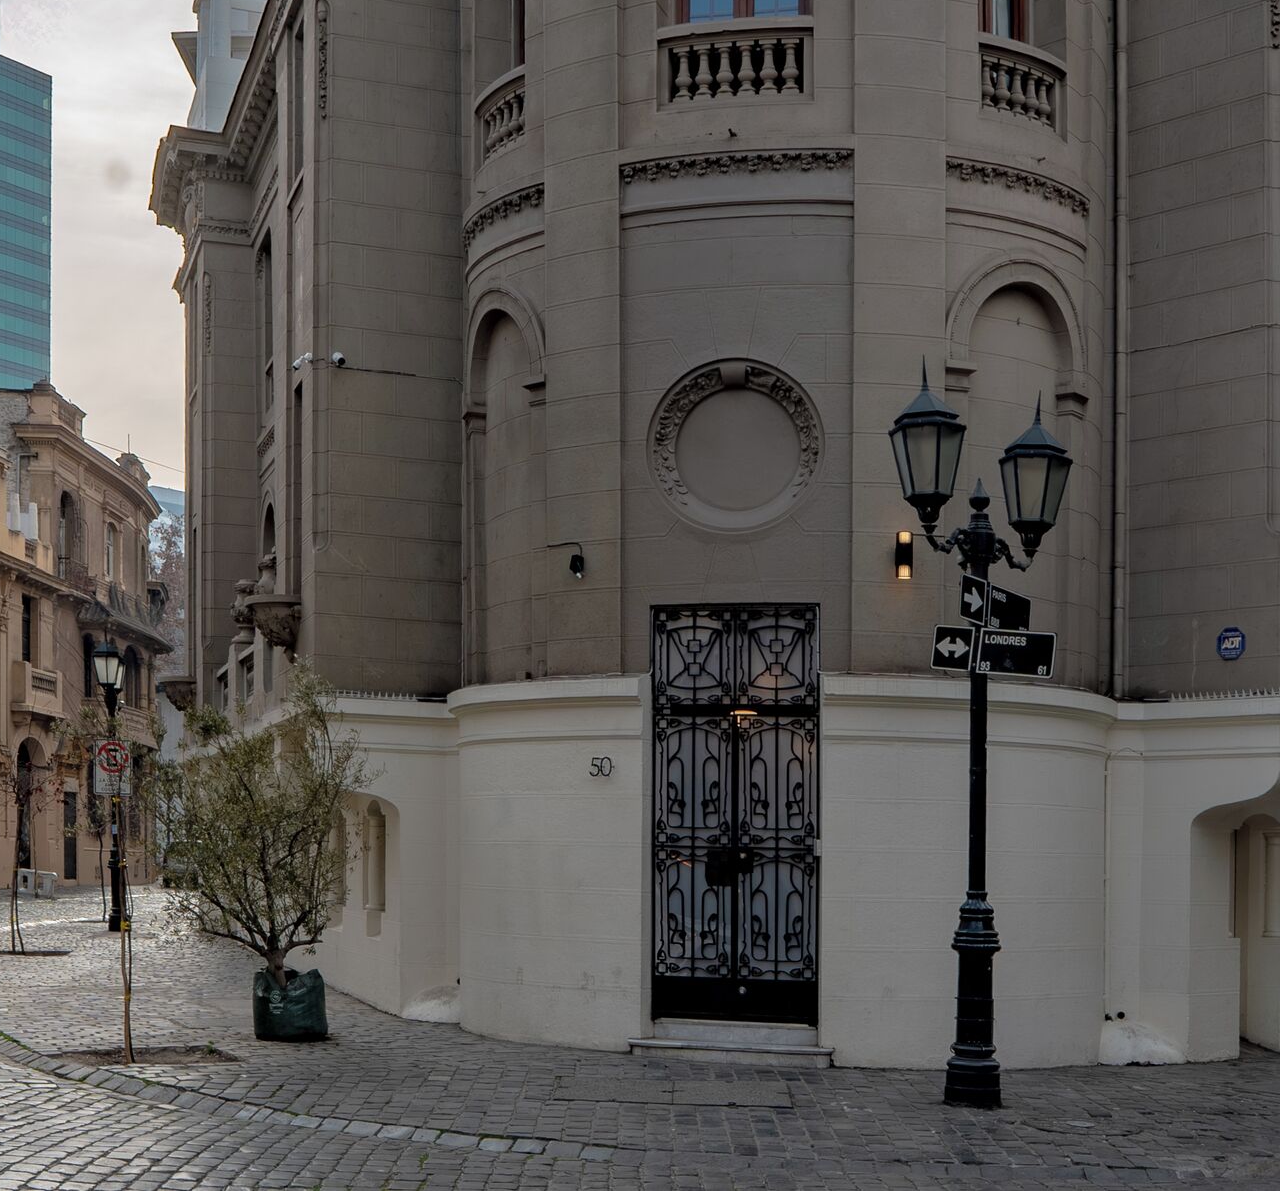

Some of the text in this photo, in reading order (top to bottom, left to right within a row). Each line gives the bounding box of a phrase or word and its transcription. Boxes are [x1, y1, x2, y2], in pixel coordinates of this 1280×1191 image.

[992, 590, 1007, 603] PARIS
[985, 634, 1027, 646] LONDRES
[1221, 637, 1242, 649] ADT
[980, 661, 991, 671] 93
[1037, 665, 1047, 675] 61
[589, 756, 613, 777] 50
